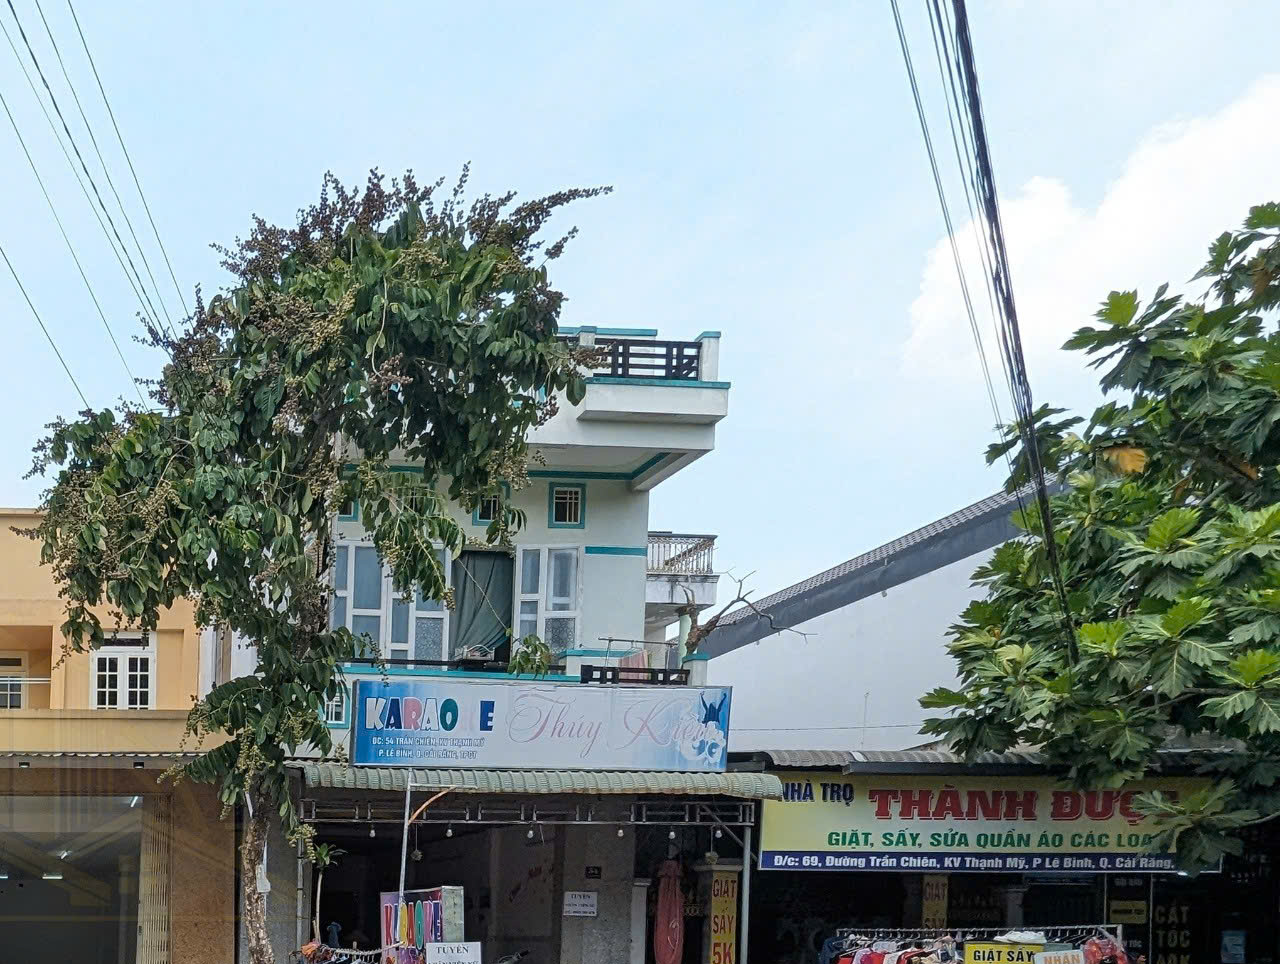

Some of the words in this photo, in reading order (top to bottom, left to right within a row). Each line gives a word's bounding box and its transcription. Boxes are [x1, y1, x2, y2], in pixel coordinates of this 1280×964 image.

[365, 696, 496, 732] KARAOE
[820, 782, 854, 806] TRỌ
[868, 784, 1038, 820] THÀNH
[828, 829, 874, 850] GIẶT,
[881, 828, 922, 849] SẤY,
[930, 828, 969, 848] SỬA
[976, 829, 1030, 848] QUẦN
[1037, 830, 1064, 848] ÁO
[1070, 830, 1109, 848] CÁC
[774, 855, 799, 866] Đ/c:
[802, 856, 822, 868] 69,
[825, 855, 866, 868] Đường
[869, 855, 896, 867] Trần
[900, 856, 940, 869] Chiên,
[944, 857, 960, 868] KV
[964, 857, 1002, 870] Thạnh
[1033, 858, 1042, 868] P
[1045, 857, 1059, 868] Lê
[1099, 858, 1111, 869] Q.
[973, 948, 1002, 963] GIẶT
[1007, 946, 1034, 962] SẤY
